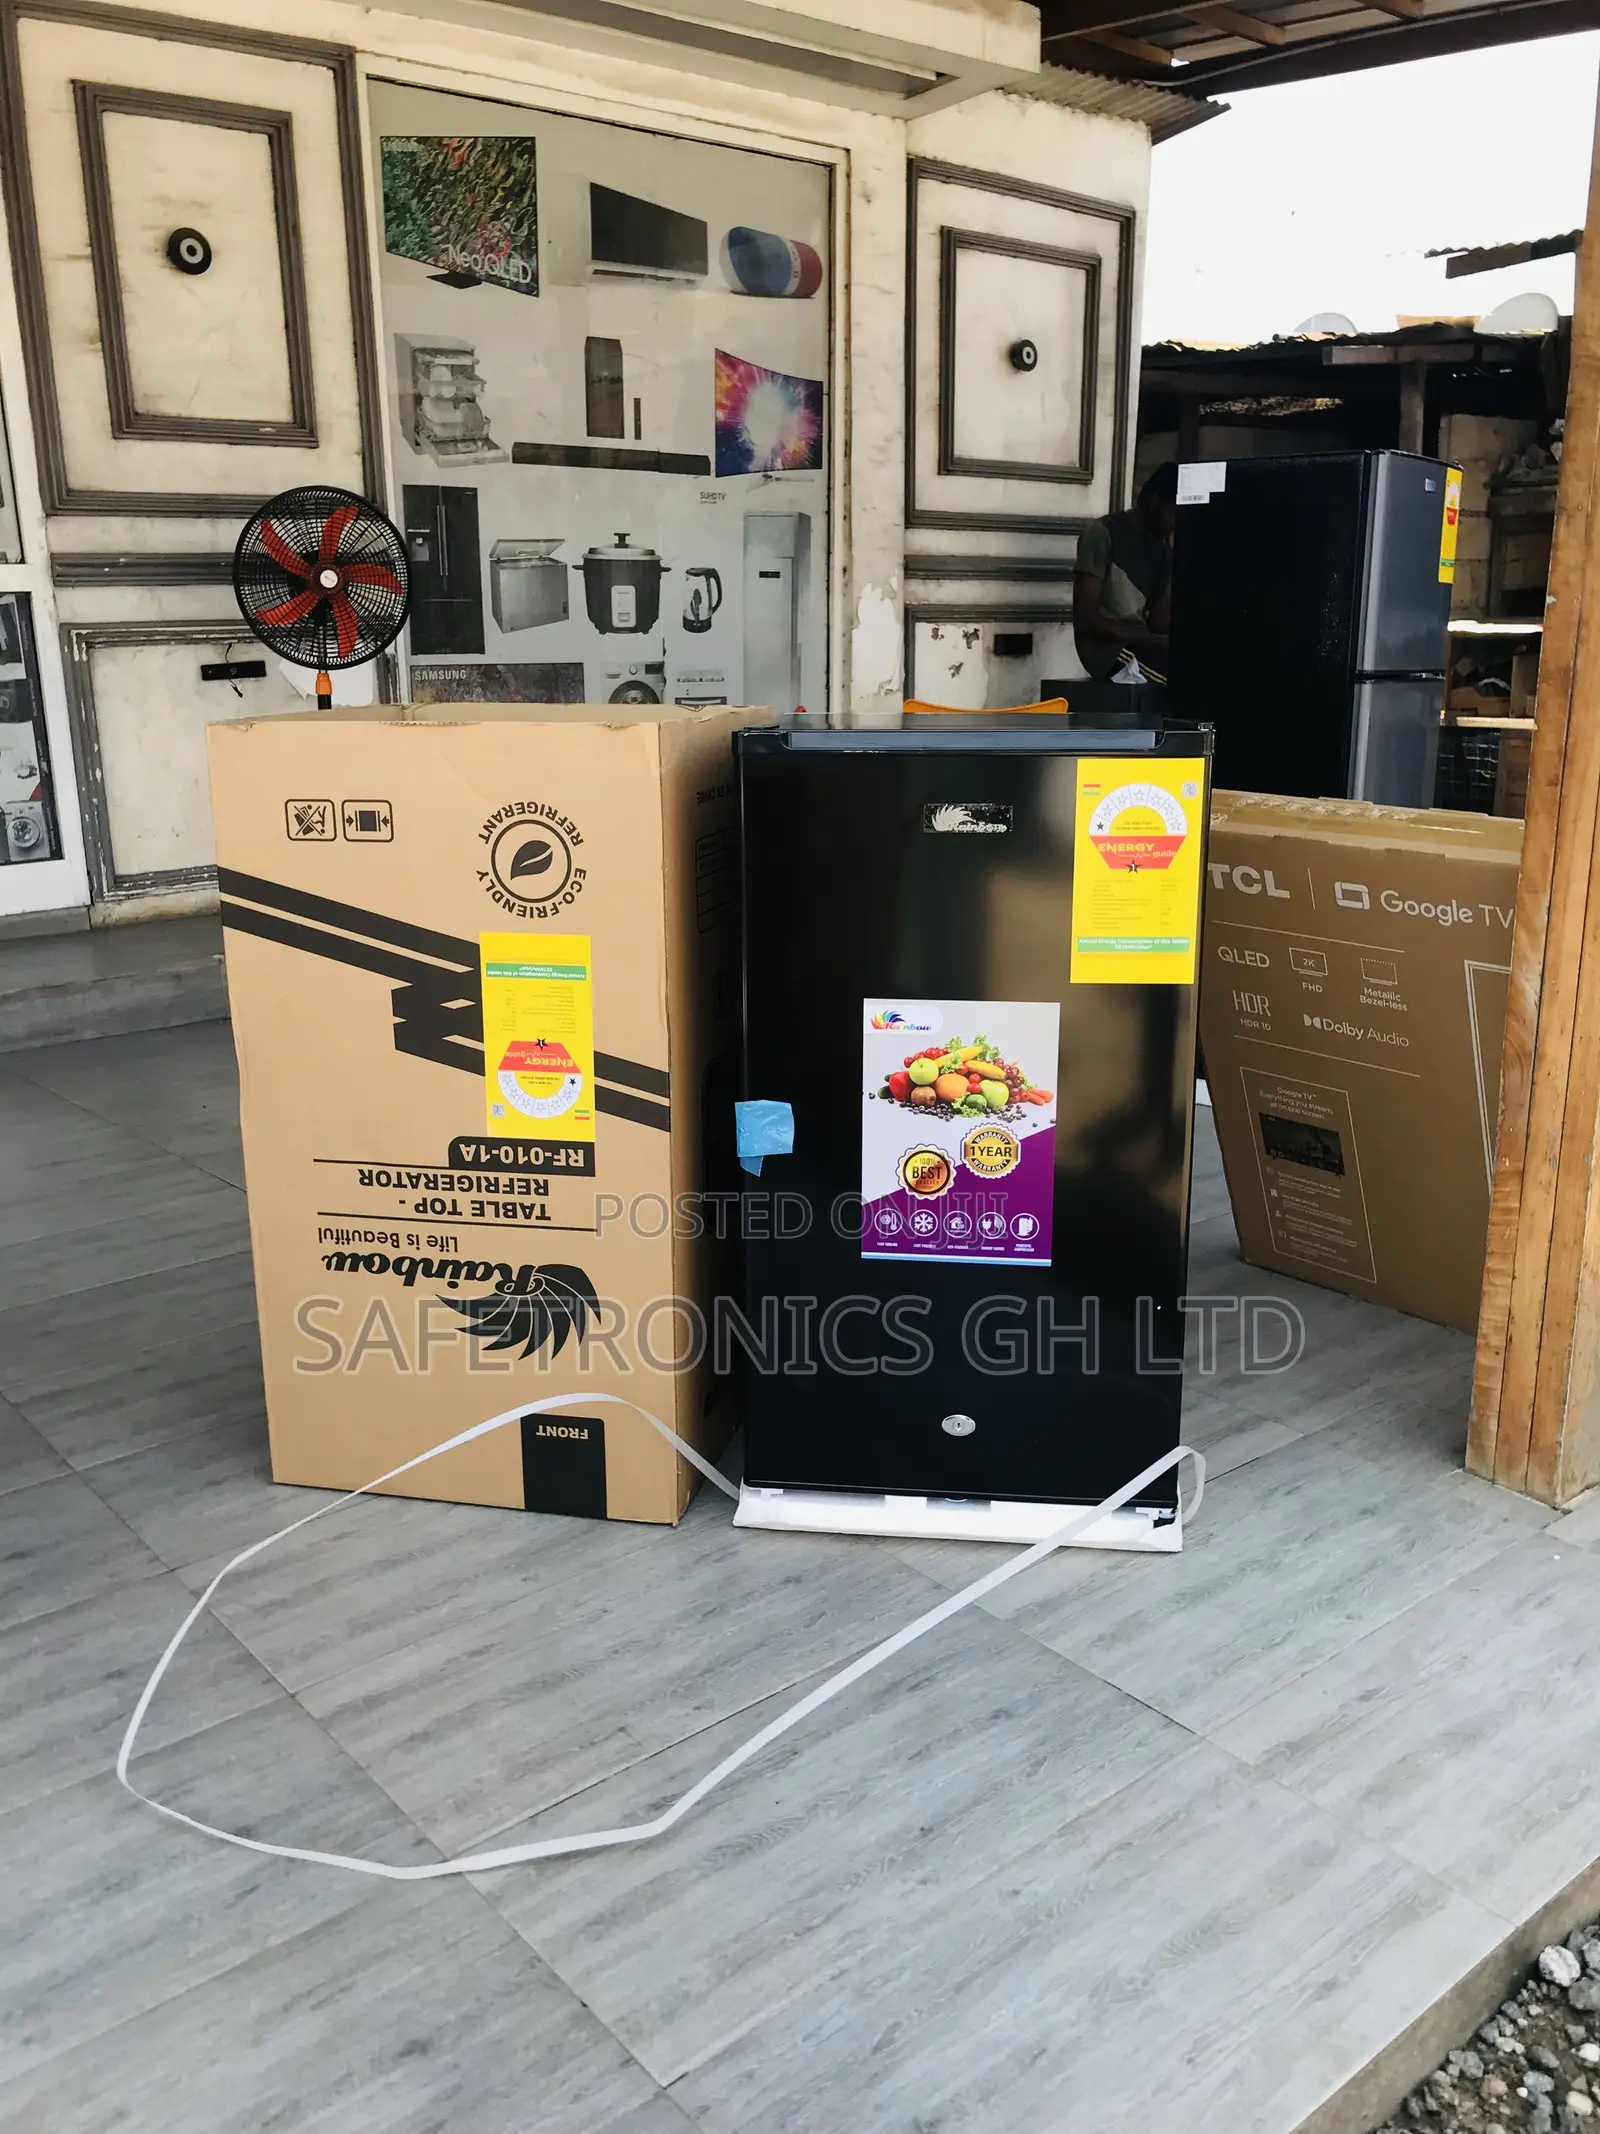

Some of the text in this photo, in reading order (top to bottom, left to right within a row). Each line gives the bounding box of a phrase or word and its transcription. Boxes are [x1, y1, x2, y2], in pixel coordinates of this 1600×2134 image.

[484, 250, 532, 284] QLED
[414, 669, 467, 680] SAMSUNG
[478, 801, 585, 847] REFRIGERANT
[1098, 841, 1156, 855] ENERGY
[1207, 862, 1291, 900] TCL
[476, 867, 587, 919] ECO-FRIENDLY
[1380, 889, 1515, 930] Google TV
[1217, 945, 1271, 969] QLED
[1302, 957, 1316, 968] 2K
[1301, 982, 1324, 994] FHD
[1363, 987, 1401, 1002] Metallic
[1232, 989, 1272, 1017] HDR
[1359, 995, 1409, 1012] Bezel-less
[1240, 1018, 1272, 1031] HDR 10
[1322, 1017, 1411, 1048] Dolby Audio
[523, 1056, 575, 1069] ENERGY
[973, 1131, 1010, 1144] WARRANTY
[458, 1143, 585, 1168] RF-010-1A
[970, 1145, 1013, 1158] 1 YEAR
[357, 1169, 550, 1197] REFRIGERATOR
[912, 1166, 943, 1180] BEST
[413, 1197, 463, 1217] TOP
[471, 1200, 551, 1221] TABLE
[317, 1227, 459, 1253] Life is Beautiful
[320, 1250, 546, 1297] Rainbow
[535, 1424, 589, 1440] FRONT
